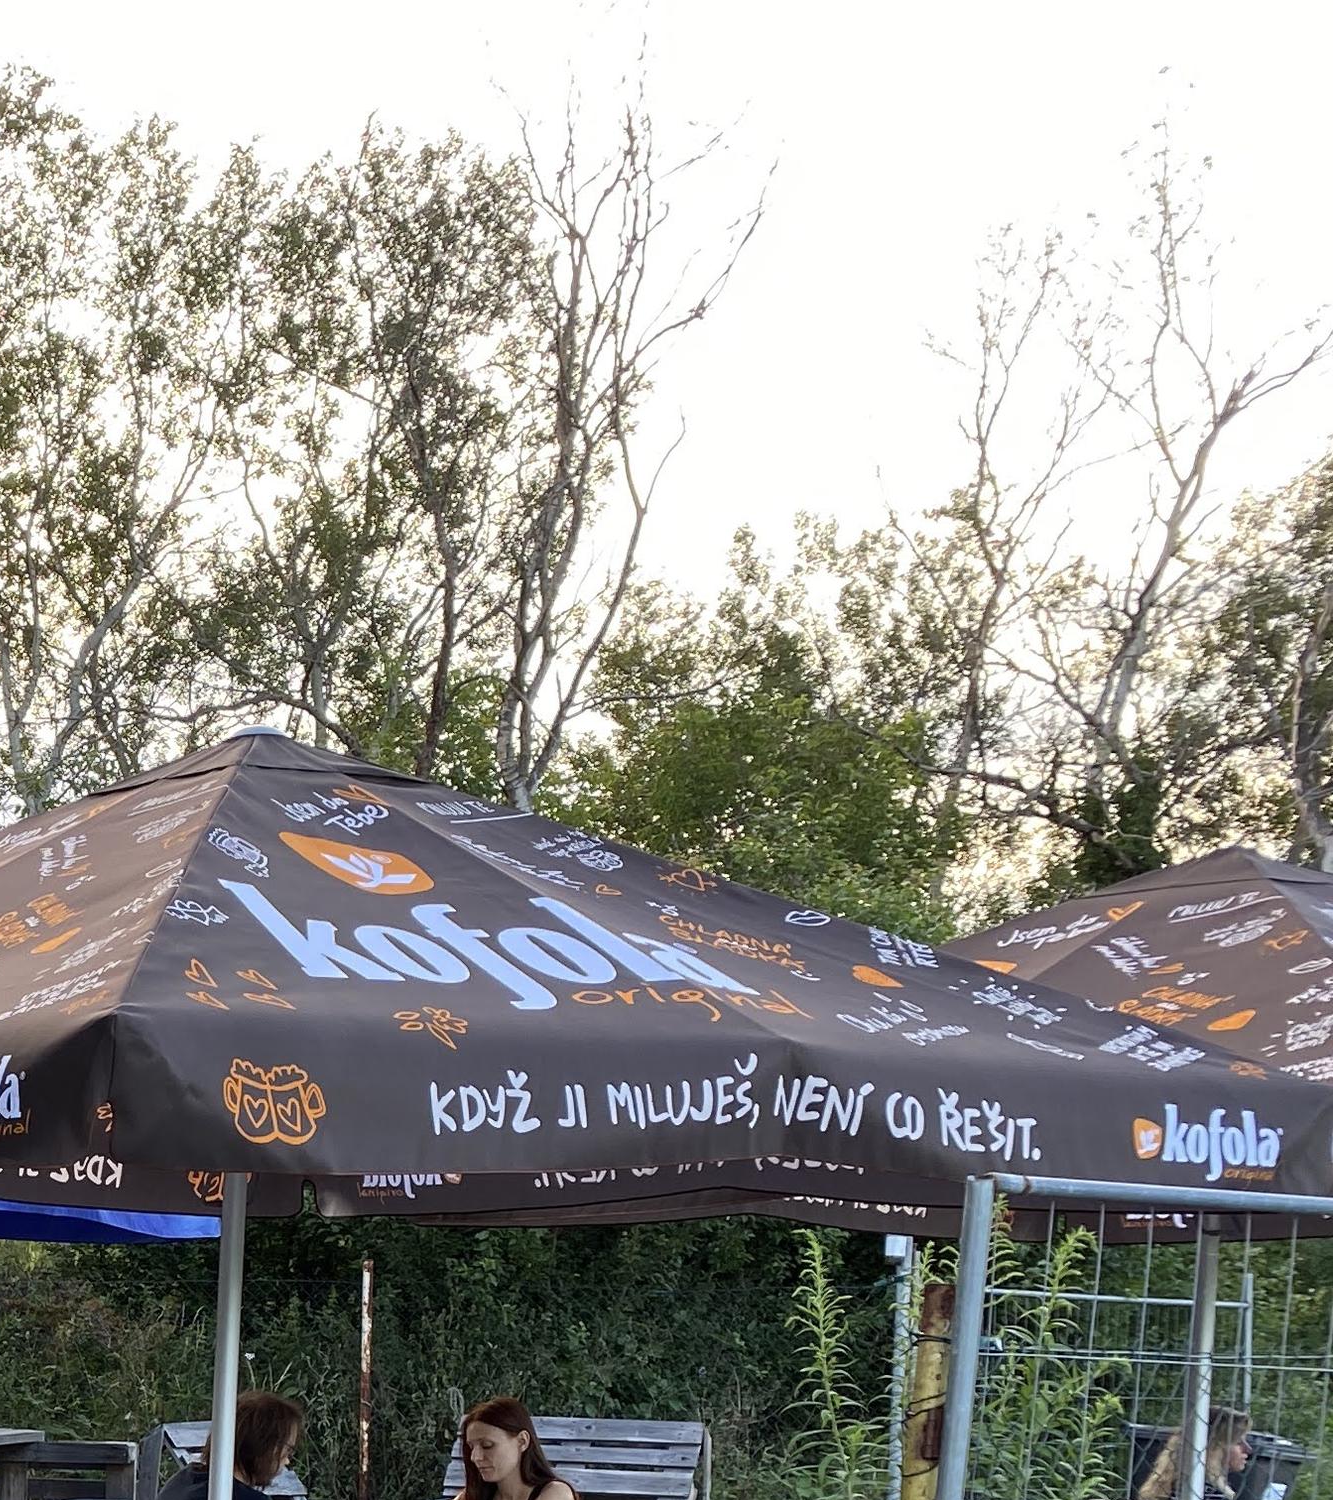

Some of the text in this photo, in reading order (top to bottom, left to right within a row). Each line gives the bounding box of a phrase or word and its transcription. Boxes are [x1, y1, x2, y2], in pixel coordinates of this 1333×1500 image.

[218, 879, 761, 1010] kofola
[430, 1052, 1042, 1161] KDYŽ JI MILUJEŠ, NENÍ CO ŘEŠIT.
[1162, 1103, 1281, 1182] kofola
